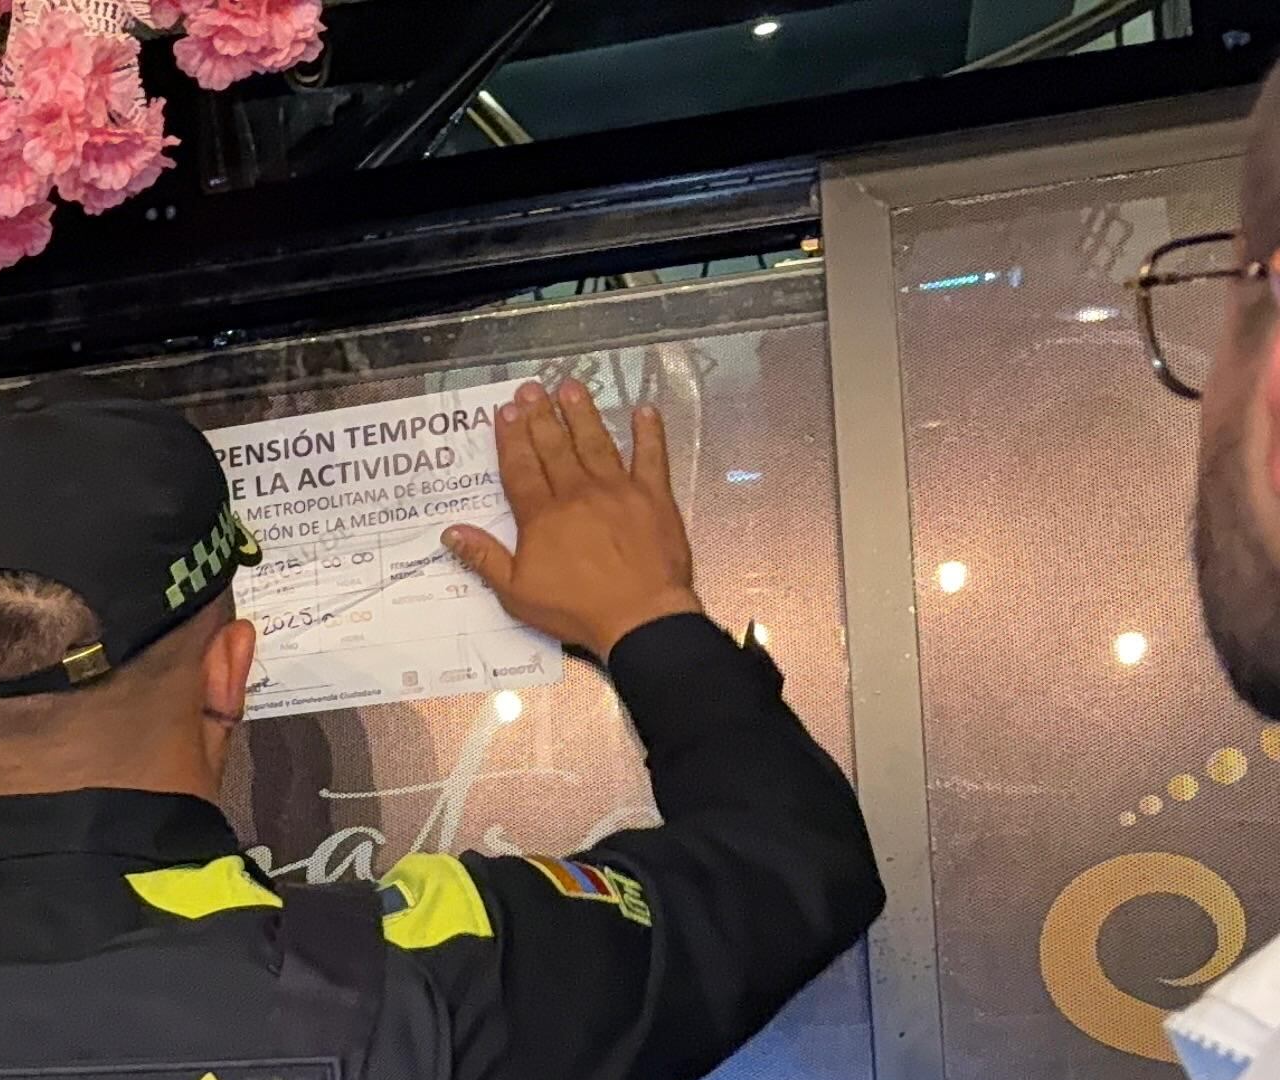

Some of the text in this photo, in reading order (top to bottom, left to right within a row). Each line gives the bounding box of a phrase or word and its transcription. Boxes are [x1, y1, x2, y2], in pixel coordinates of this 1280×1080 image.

[214, 428, 335, 468] PENSIÓN
[255, 472, 290, 498] LA
[297, 446, 456, 491] ACTIVIDAD
[246, 487, 389, 522] METROPOLITANA
[393, 482, 417, 500] DE
[252, 523, 294, 543] CIÓN
[299, 520, 321, 537] DE
[325, 517, 346, 533] LA
[350, 505, 418, 528] MEDIDA
[423, 492, 503, 517] CORRECT
